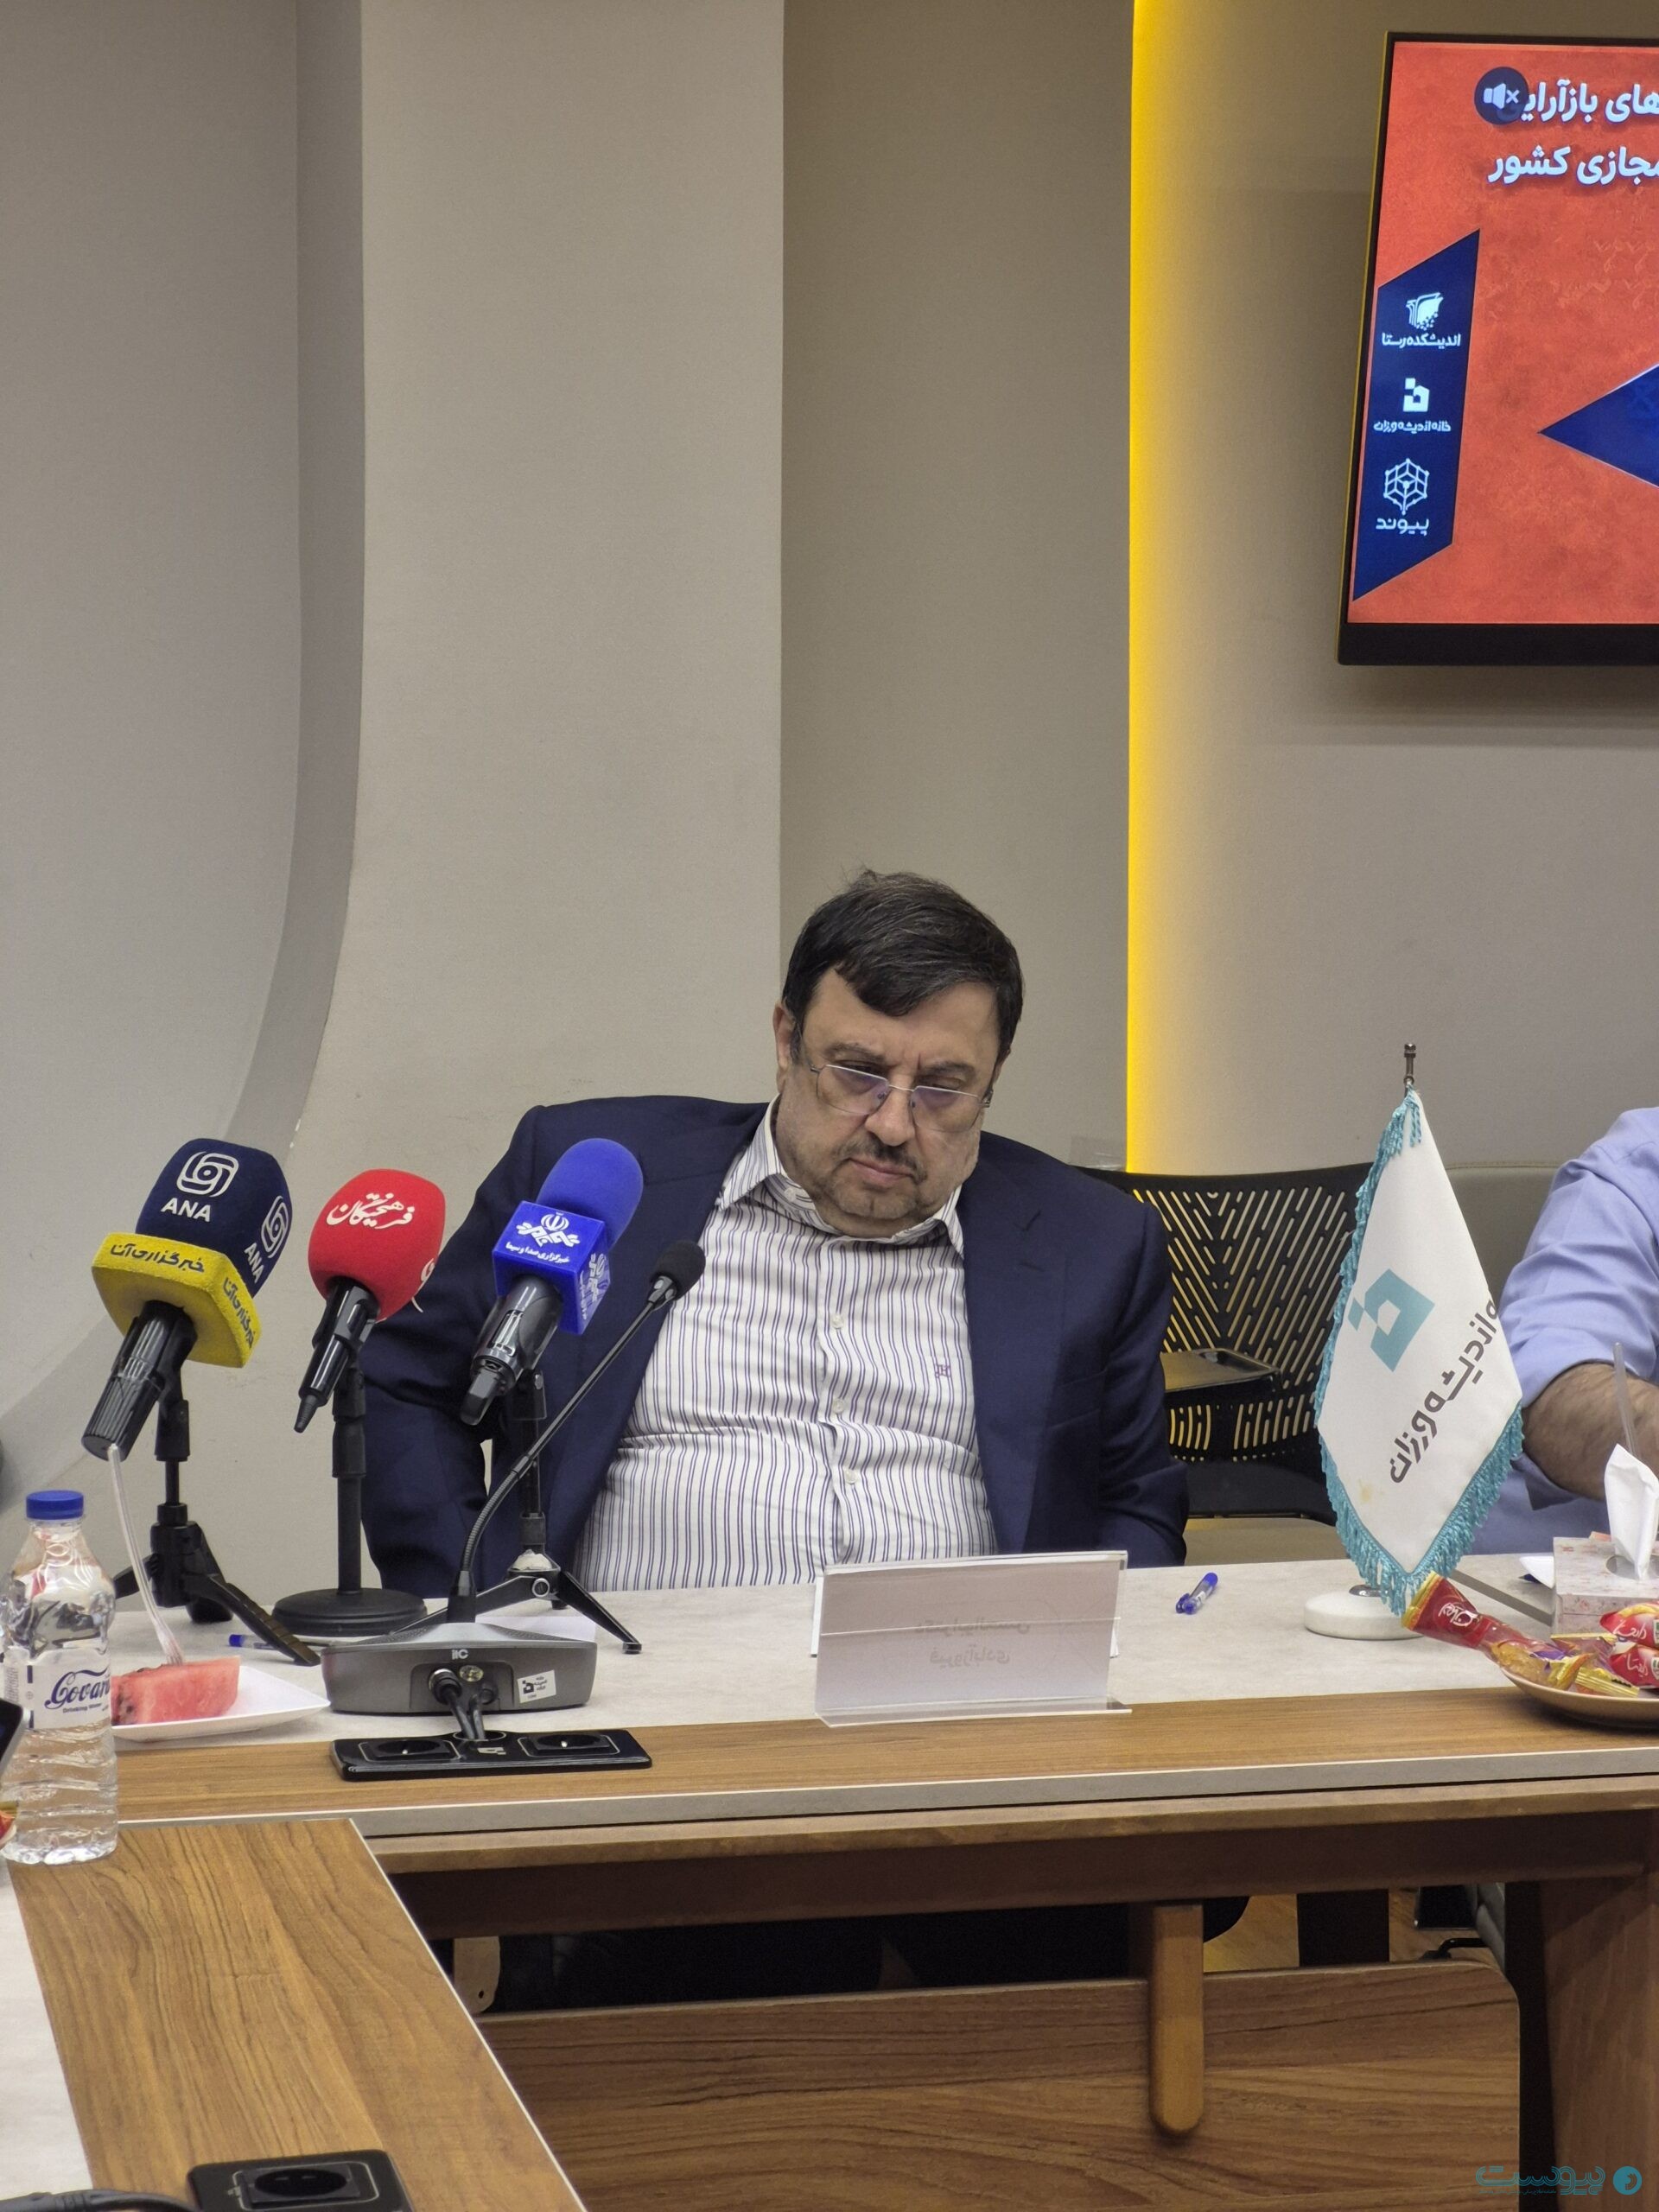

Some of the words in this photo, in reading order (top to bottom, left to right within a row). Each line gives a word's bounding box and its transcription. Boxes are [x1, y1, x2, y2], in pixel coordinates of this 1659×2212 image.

[1498, 79, 1598, 123] بازآرای
[1488, 145, 1571, 184] کشور
[1376, 518, 1429, 537] پیوند
[161, 1198, 212, 1223] ANA
[244, 1243, 265, 1284] ANA
[1389, 1409, 1438, 1484] ورزان
